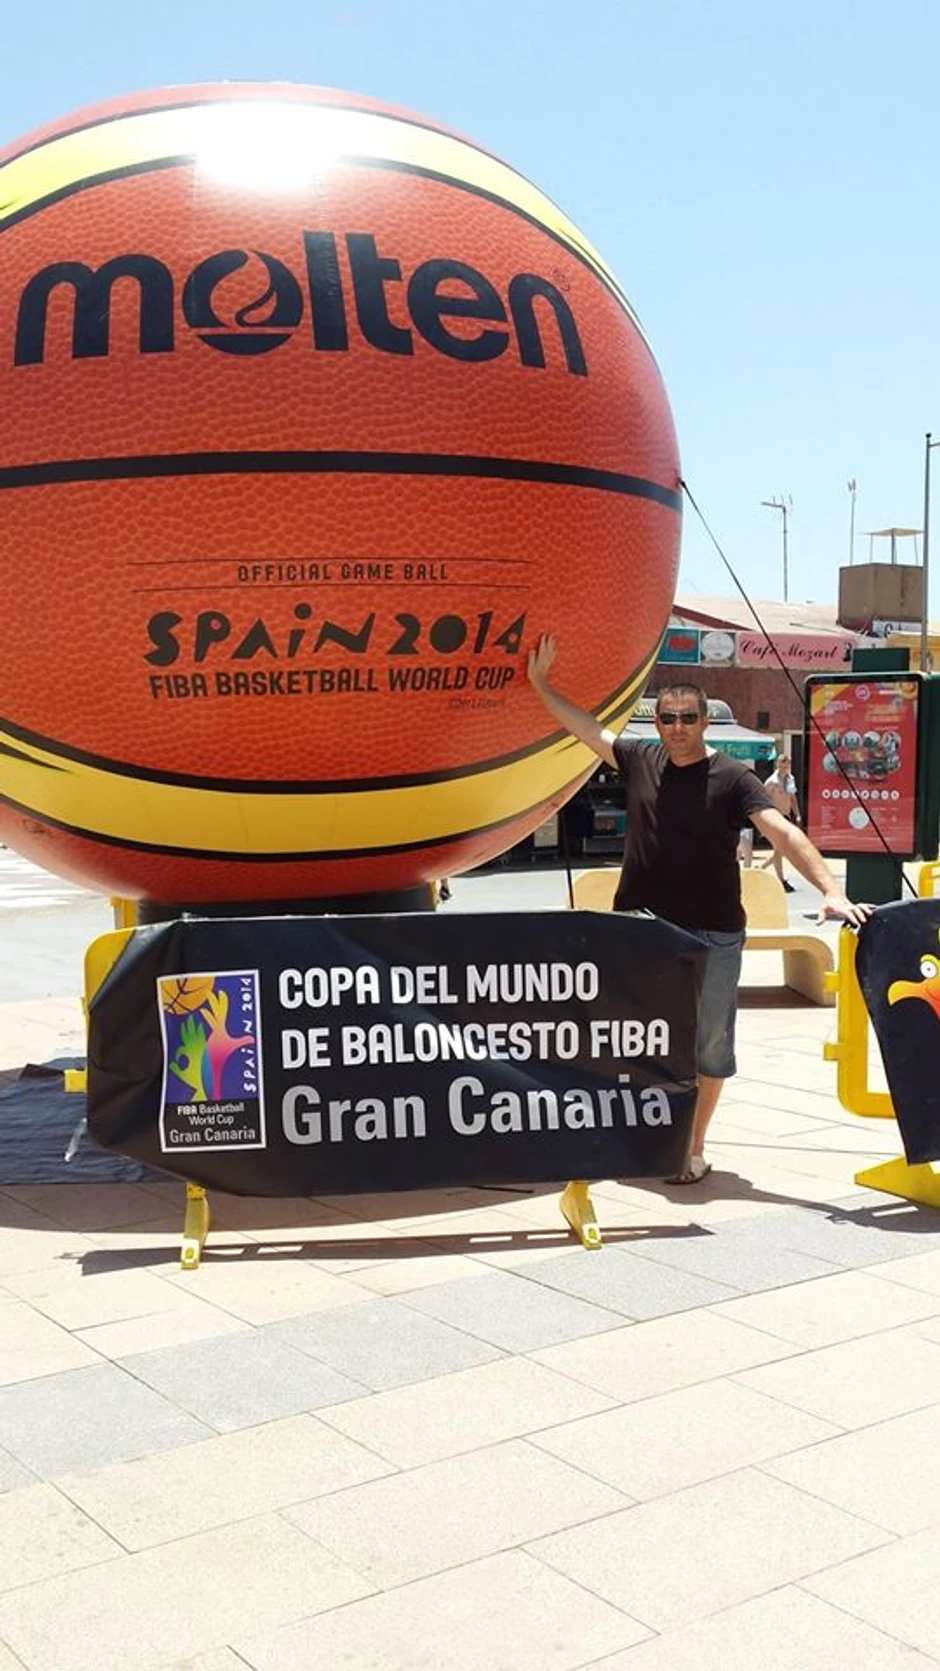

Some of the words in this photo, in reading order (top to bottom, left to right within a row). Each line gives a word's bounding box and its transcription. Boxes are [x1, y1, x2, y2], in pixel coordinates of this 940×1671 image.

[14, 231, 588, 377] molten
[238, 563, 332, 582] OFFICIAL
[341, 563, 394, 579] GAME
[403, 563, 449, 580] BALL
[386, 611, 528, 656] 2014
[781, 642, 838, 662] Mozart
[149, 671, 207, 700] FIBA
[215, 668, 379, 697] BASKETBALL
[388, 667, 467, 693] WORLD
[474, 667, 515, 692] CUP
[240, 977, 253, 1012] 2014
[278, 966, 380, 1009] COPA
[391, 964, 458, 1004] DEL
[467, 962, 599, 1003] MUNDO
[281, 1026, 331, 1069] DE
[343, 1022, 577, 1064] BALONCESTO
[591, 1018, 670, 1059] FIBA
[177, 1104, 198, 1115] FIBA
[200, 1102, 245, 1114] Basketball
[189, 1115, 214, 1126] World
[216, 1114, 235, 1126] Cup
[282, 1084, 427, 1146] Gran
[448, 1074, 673, 1134] Canaria
[169, 1129, 201, 1143] Gran
[204, 1126, 256, 1142] Canaria
